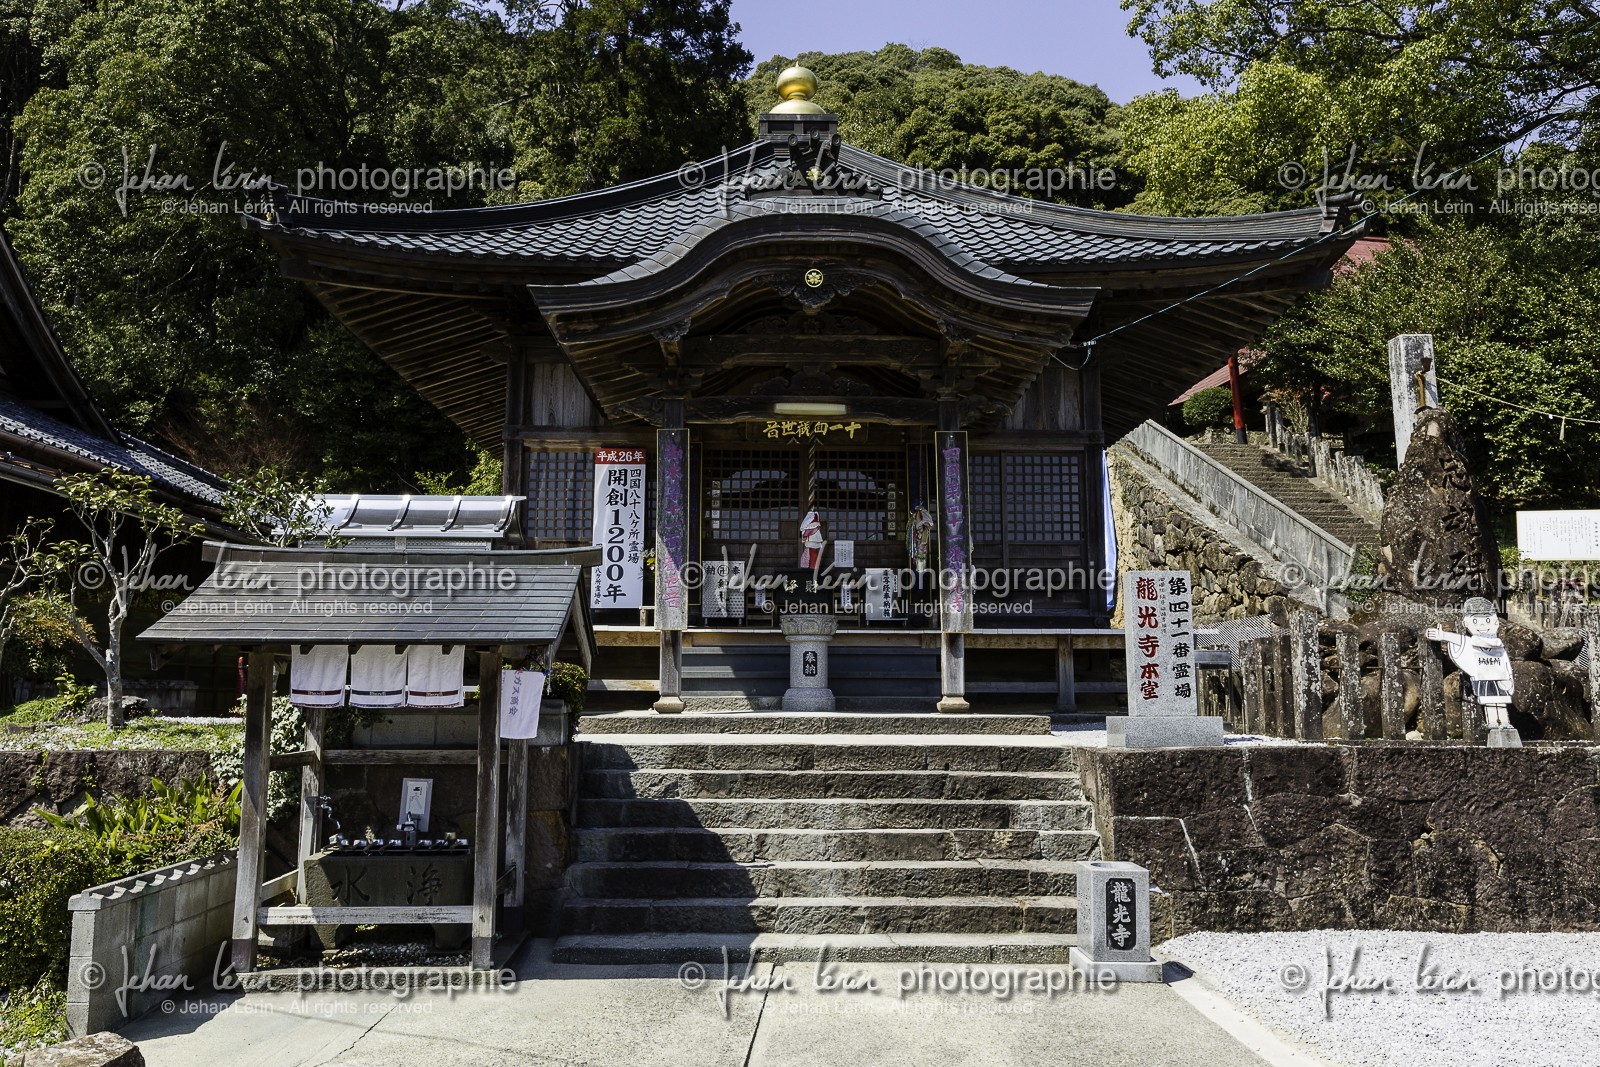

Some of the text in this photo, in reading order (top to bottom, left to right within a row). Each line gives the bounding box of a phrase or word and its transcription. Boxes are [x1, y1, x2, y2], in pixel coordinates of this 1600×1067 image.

[597, 451, 644, 462] 平成26年
[602, 468, 628, 604] 開創1200年
[804, 651, 817, 675] 奉納
[1135, 576, 1160, 700] 龍光寺本堂
[1168, 576, 1192, 699] 第四十一番霊場
[1110, 881, 1132, 948] 龍光寺
